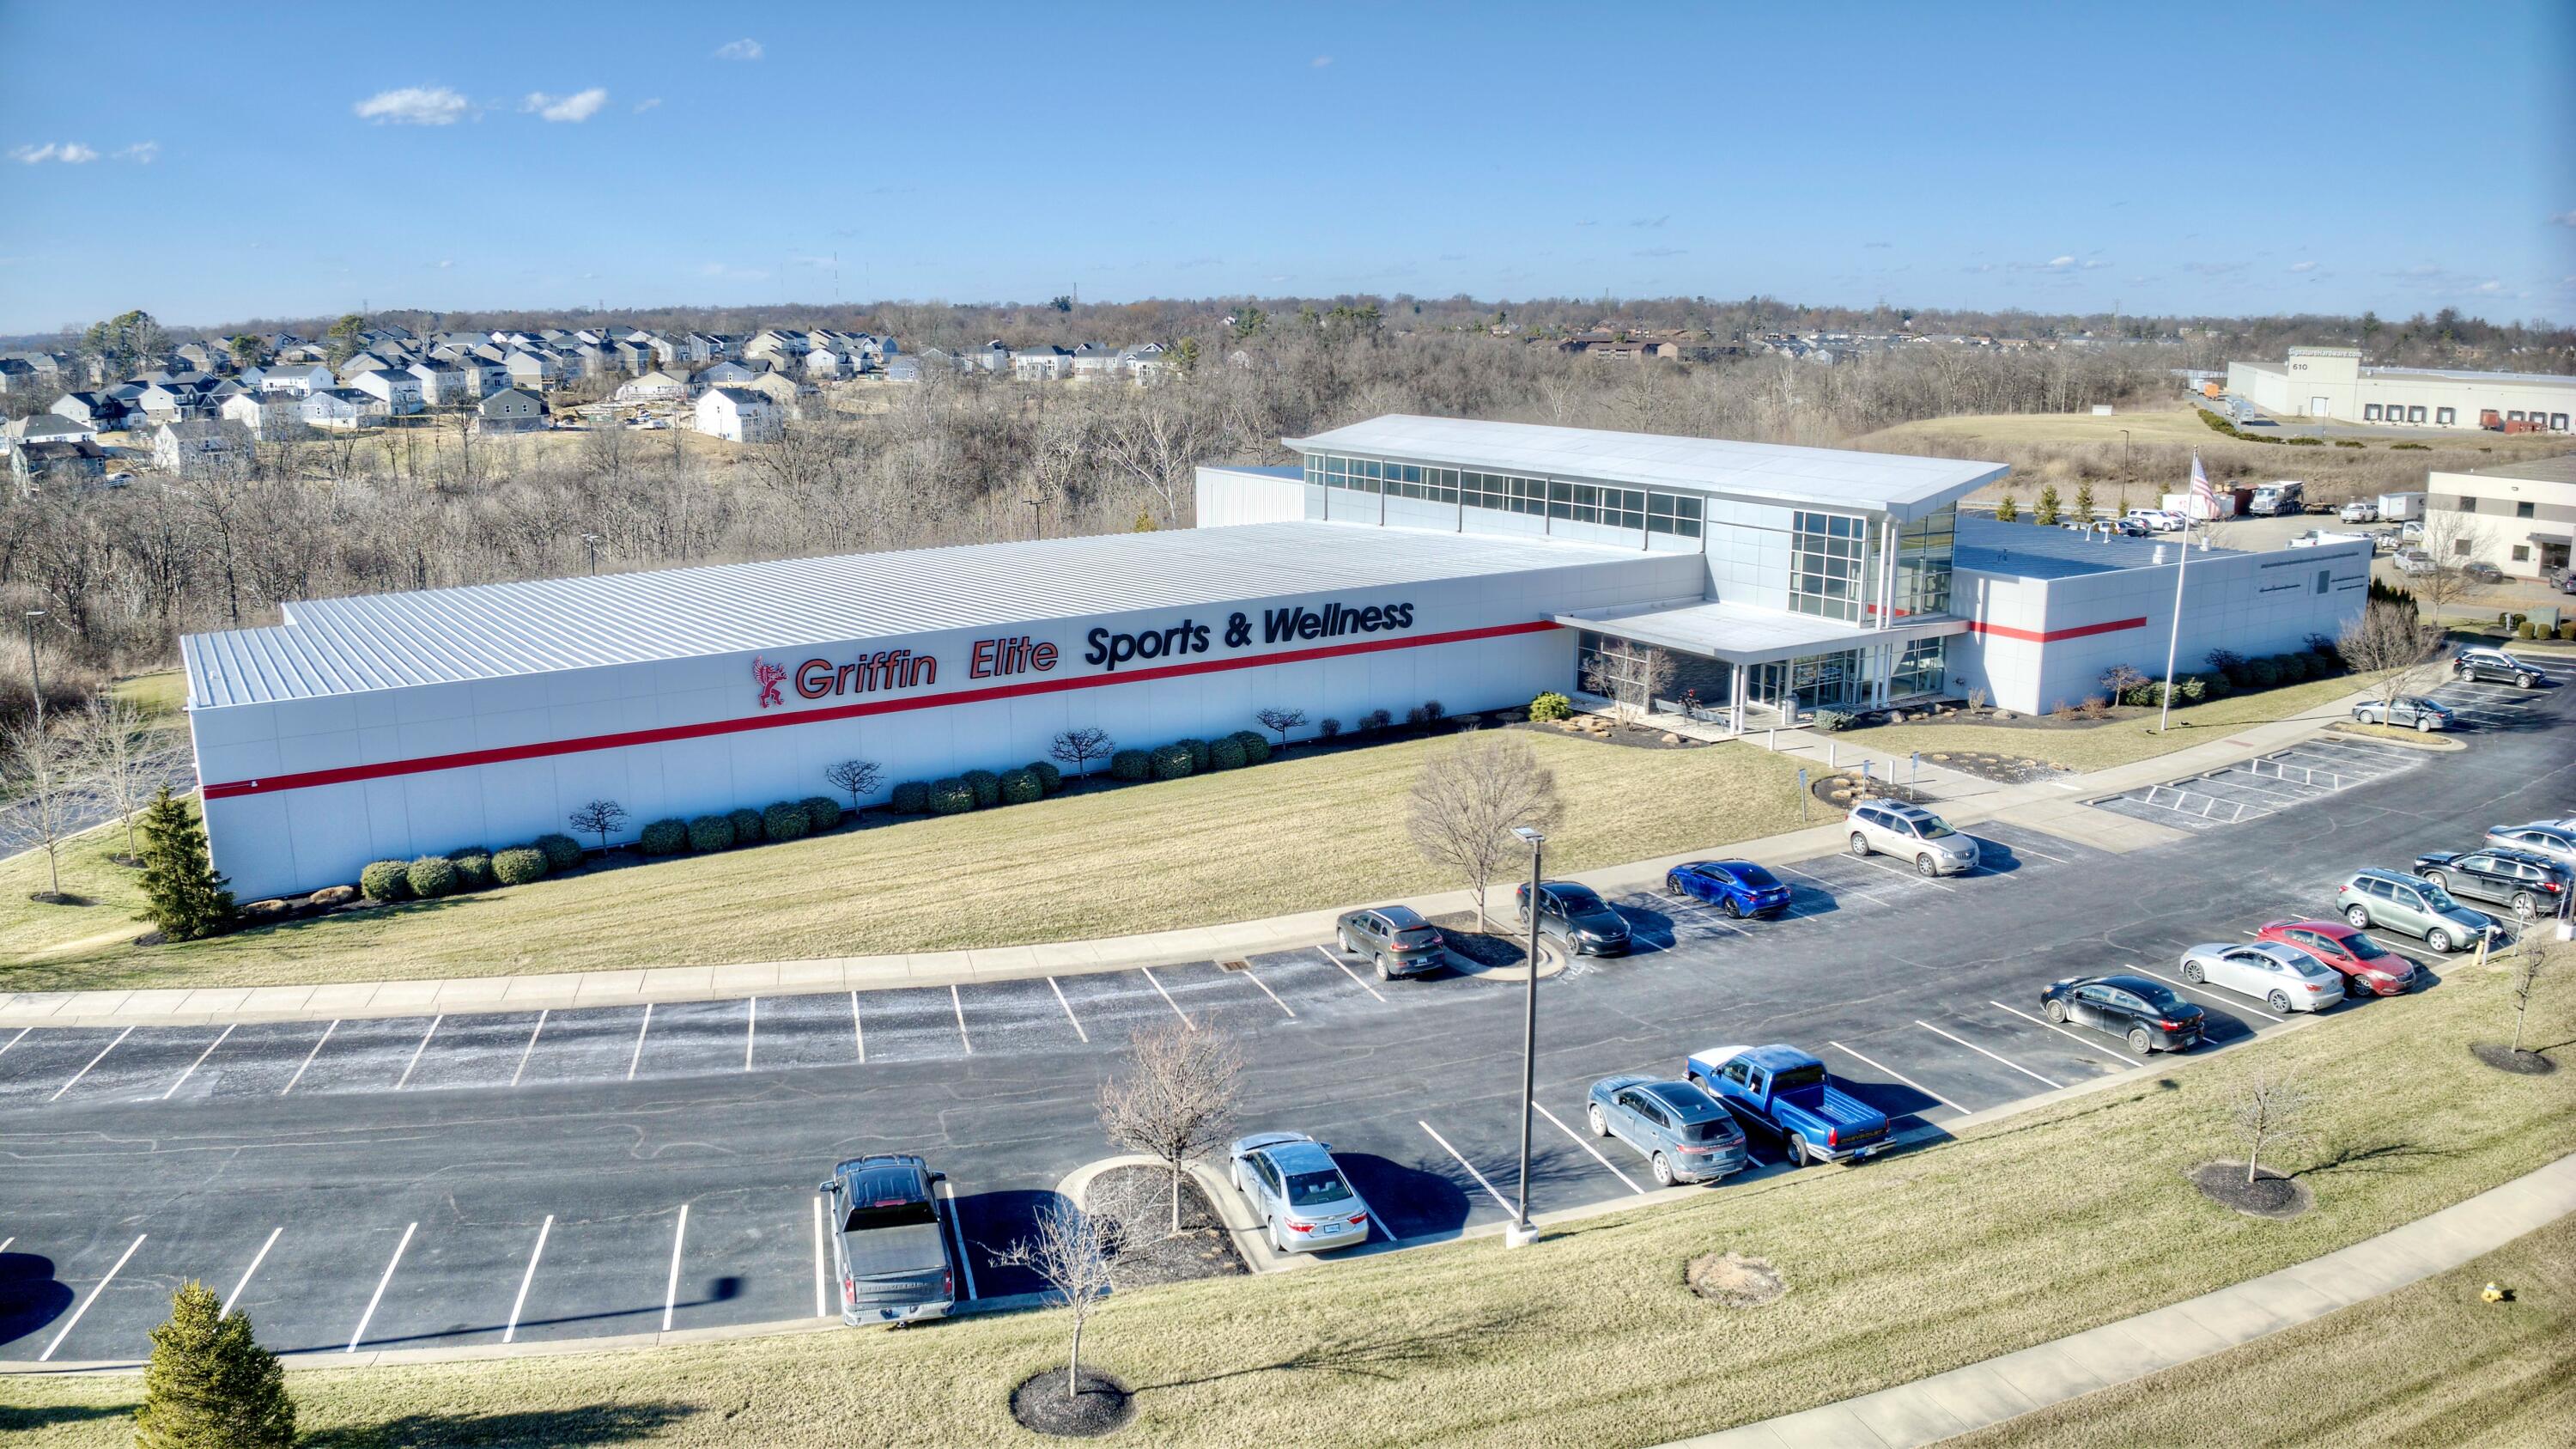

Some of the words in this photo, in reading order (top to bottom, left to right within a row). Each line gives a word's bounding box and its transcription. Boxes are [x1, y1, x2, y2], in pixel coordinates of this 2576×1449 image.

[795, 649, 937, 699] Griffin
[969, 636, 1059, 679] Elite
[1084, 618, 1211, 671] Sports
[1224, 612, 1253, 648] &
[1265, 602, 1414, 644] Wellness
